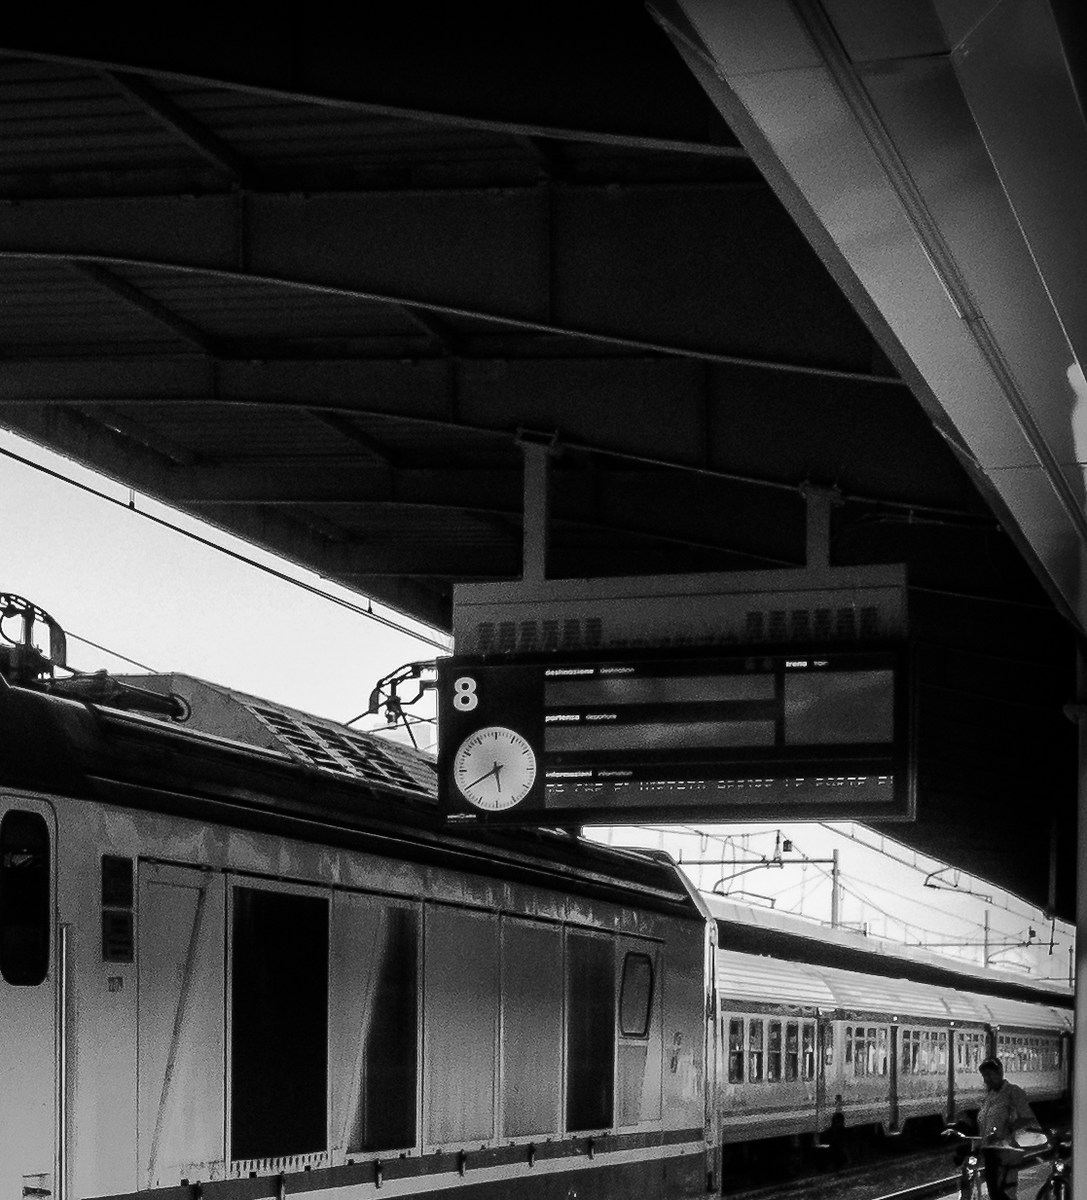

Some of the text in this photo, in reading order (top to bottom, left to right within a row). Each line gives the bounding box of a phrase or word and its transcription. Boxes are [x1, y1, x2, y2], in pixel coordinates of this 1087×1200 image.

[544, 668, 594, 676] destinazione
[453, 676, 479, 712] 8
[544, 714, 580, 723] partenza
